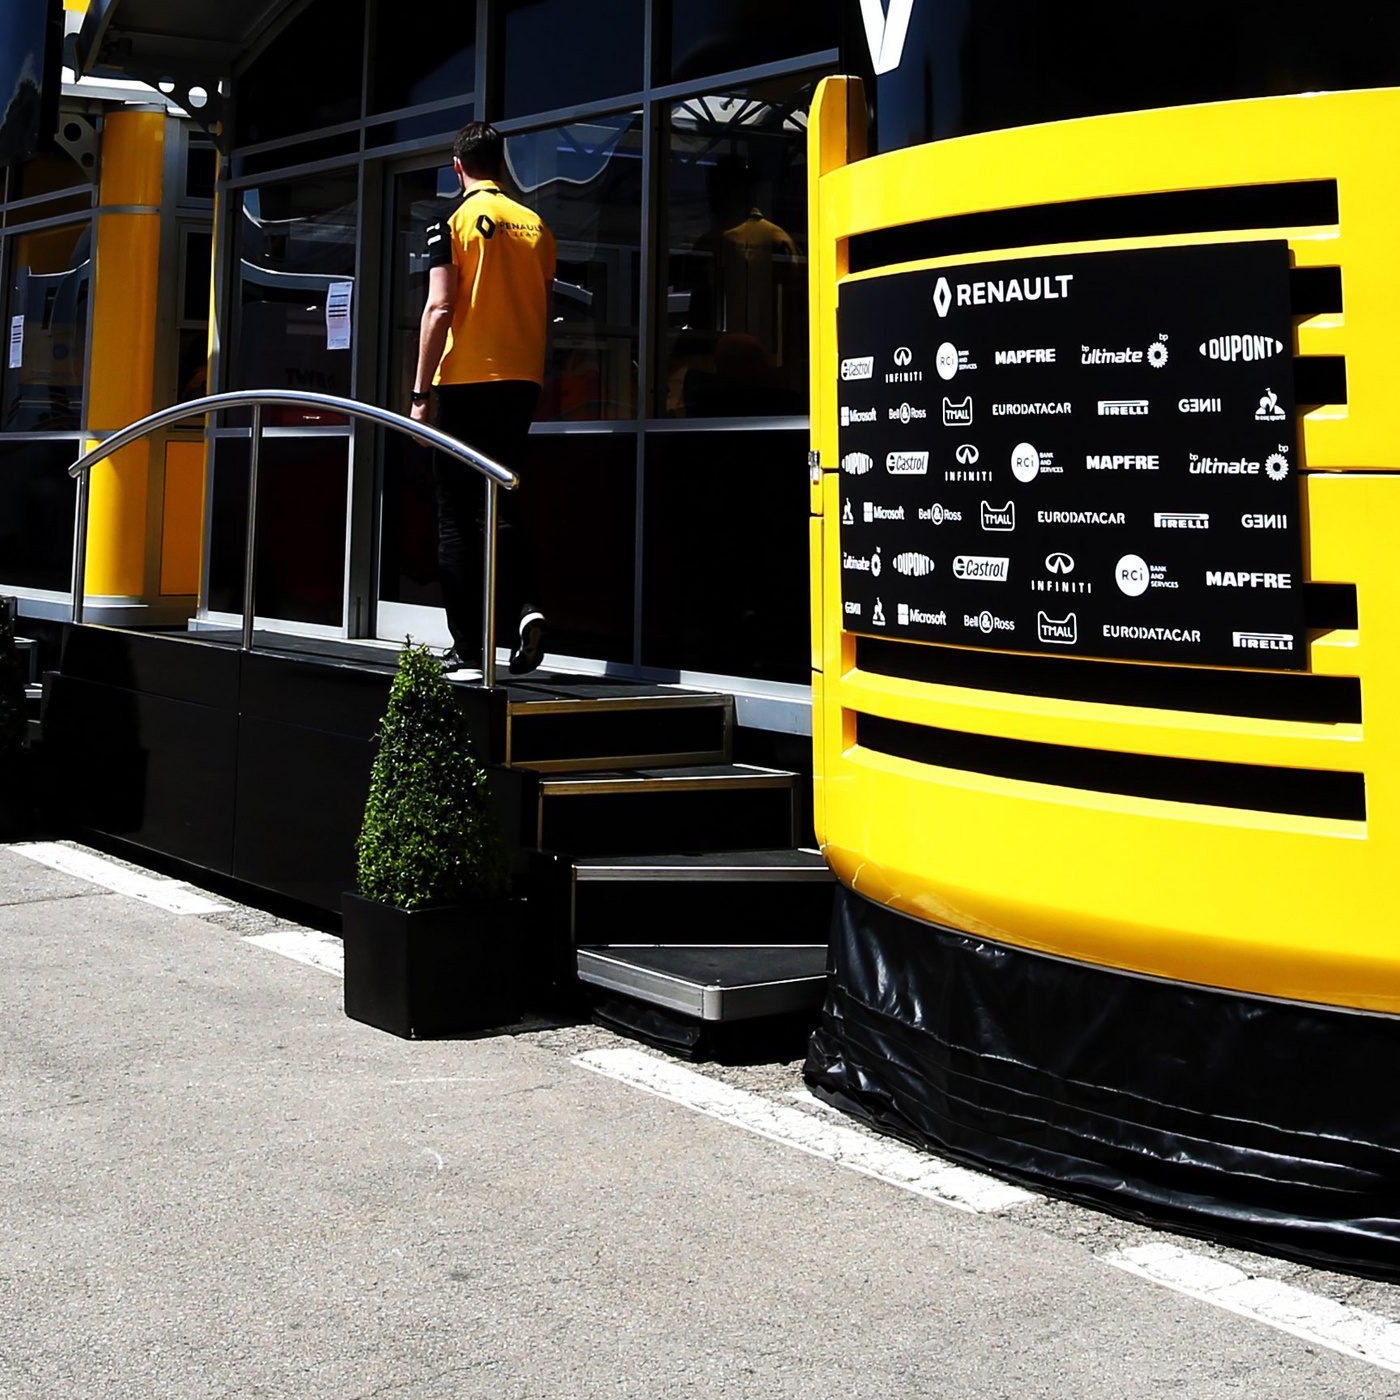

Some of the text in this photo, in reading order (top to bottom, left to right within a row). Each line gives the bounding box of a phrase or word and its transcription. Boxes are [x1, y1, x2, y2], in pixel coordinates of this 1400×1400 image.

[956, 274, 1073, 306] RENAULT
[1158, 333, 1168, 342] bp
[1081, 347, 1143, 364] ultimate
[1208, 334, 1274, 362] DUPONT
[995, 348, 1056, 365] MAPFRE
[885, 371, 922, 383] INFINITI
[945, 409, 969, 420] TMALL
[992, 402, 1071, 416] EURODATACAR
[1097, 400, 1149, 415] PIRELLI
[1278, 444, 1289, 453] bp
[896, 455, 925, 471] Castrol
[1016, 454, 1034, 467] RCi
[1086, 455, 1159, 470] MAPFRE
[1189, 453, 1199, 461] bp
[1189, 457, 1260, 474] ultimate
[945, 471, 992, 482] INFINITI
[873, 505, 905, 520] Microsoft
[984, 513, 1012, 525] TMALL
[1037, 511, 1126, 525] EURODATACAR
[1154, 512, 1210, 529] PIRELLI
[897, 552, 930, 577] DUPONT
[966, 559, 1004, 577] Castrol
[1122, 567, 1143, 582] RCi
[1206, 571, 1291, 589] MAPFRE
[1031, 579, 1092, 594] INFINITI
[909, 608, 947, 626] Microsoft
[963, 614, 978, 627] Bell
[994, 617, 1015, 631] Ross
[1041, 624, 1074, 638] TMALL
[1103, 624, 1200, 643] EURODATACAR
[1232, 631, 1294, 650] PIRELLI
